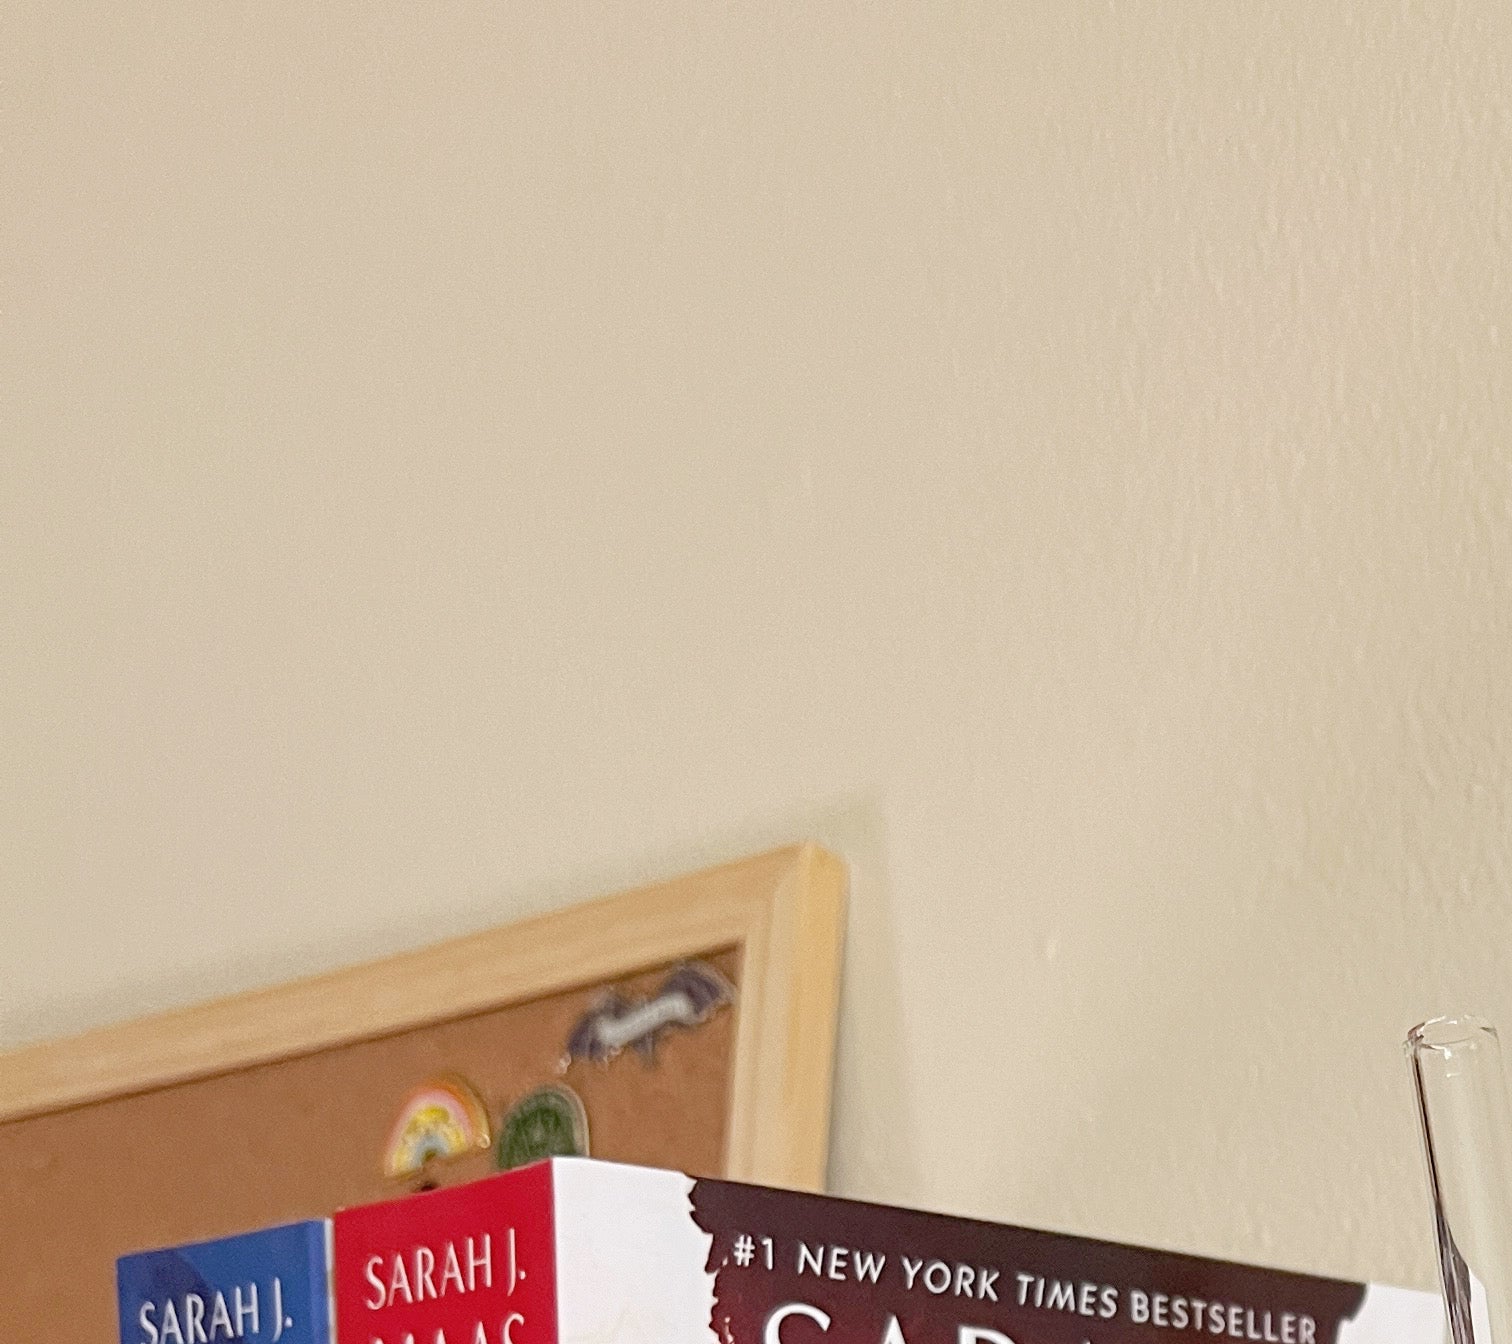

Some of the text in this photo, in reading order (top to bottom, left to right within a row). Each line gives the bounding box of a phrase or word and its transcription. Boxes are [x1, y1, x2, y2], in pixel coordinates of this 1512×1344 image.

[270, 1276, 294, 1342] J.
[365, 1228, 527, 1310] SARAH J.
[733, 1234, 774, 1270] #1
[797, 1241, 886, 1283] NEW
[902, 1256, 1001, 1301] YORK
[1016, 1273, 1118, 1319] TIMES
